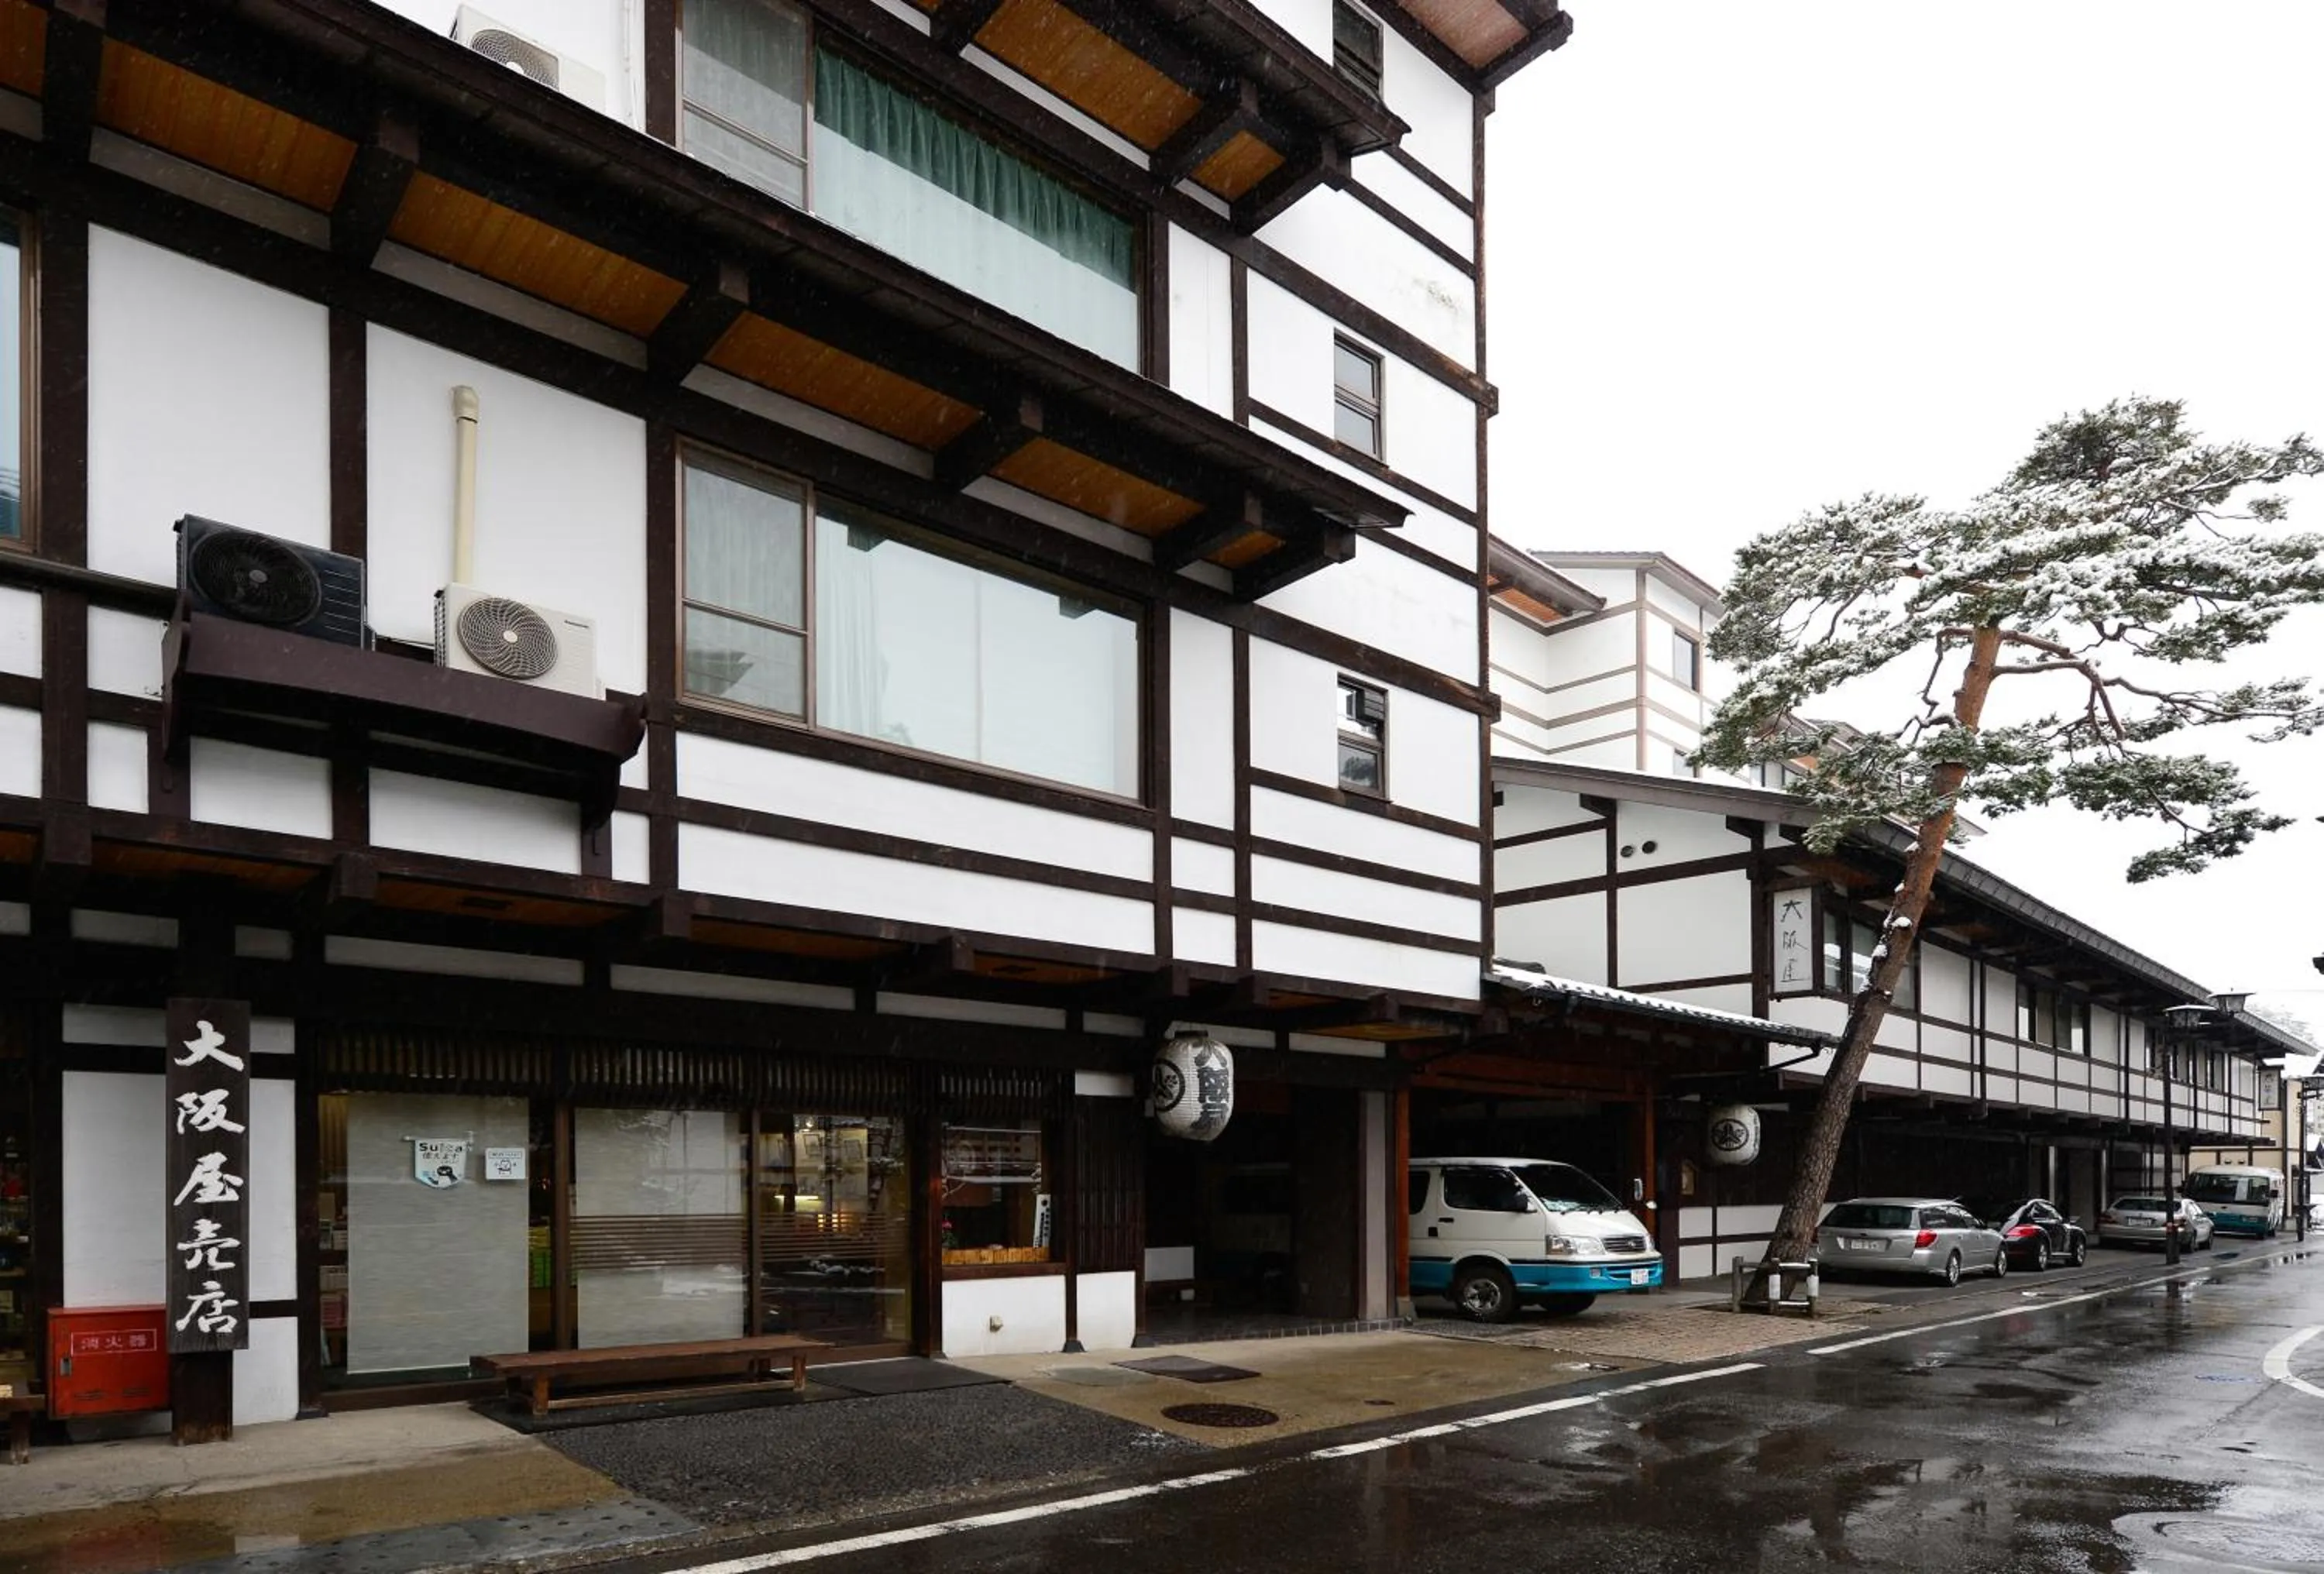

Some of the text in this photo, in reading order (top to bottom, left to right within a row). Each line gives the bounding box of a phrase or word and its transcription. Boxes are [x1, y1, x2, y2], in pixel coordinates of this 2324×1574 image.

[1780, 900, 1810, 983] 大阪屋
[174, 1020, 246, 1332] 大阪屋売店
[81, 1334, 146, 1349] 消火器
